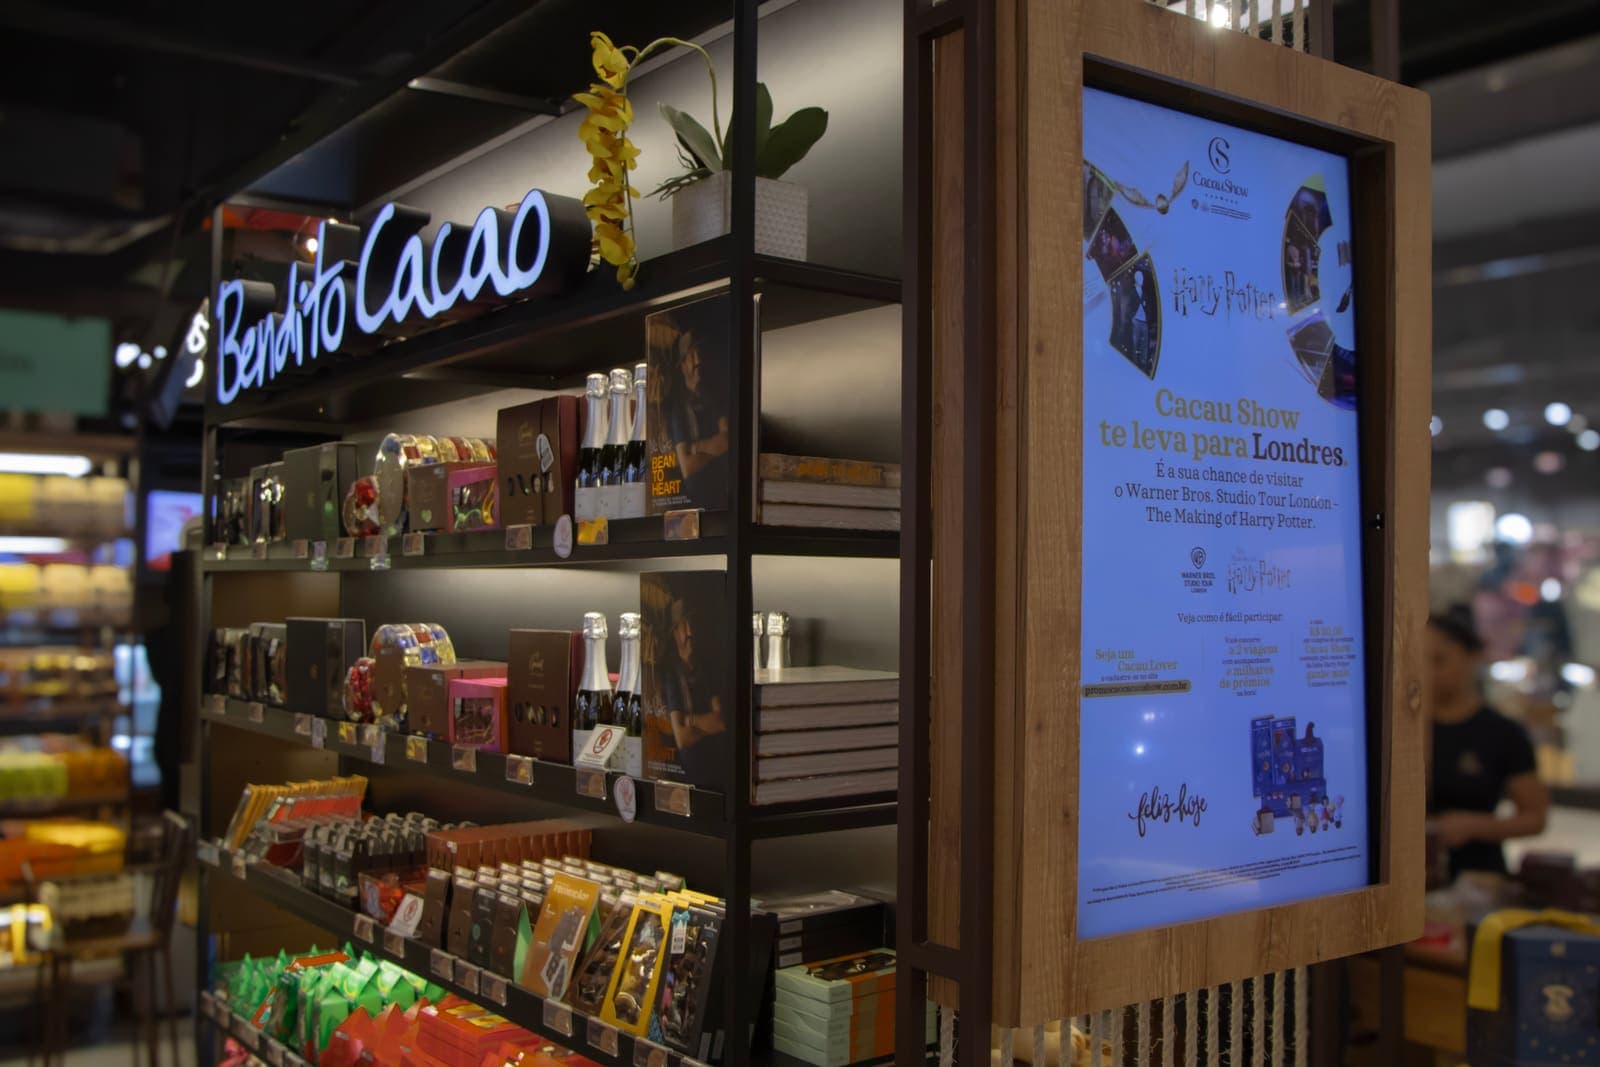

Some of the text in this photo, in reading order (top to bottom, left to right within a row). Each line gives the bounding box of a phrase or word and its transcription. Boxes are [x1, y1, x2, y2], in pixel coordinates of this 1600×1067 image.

[216, 219, 346, 404] Bendito
[354, 187, 551, 334] Cacao
[1172, 266, 1277, 322] Harry Potter
[1155, 388, 1300, 431] Cacau Show
[1099, 419, 1127, 448] te
[1132, 421, 1188, 453] leva
[1191, 434, 1249, 462] para
[651, 453, 676, 470] BEAN
[652, 468, 665, 483] TO
[1156, 458, 1304, 488] É a sua chance de visitar
[651, 479, 682, 497] HEART
[1114, 486, 1123, 498] o
[1126, 482, 1179, 502] Warner
[1181, 486, 1213, 504] Bros.
[1216, 488, 1255, 506] Studio
[1258, 491, 1286, 508] Tour
[1288, 493, 1332, 510] London
[1146, 506, 1316, 531] The Making of Harry Potter.
[1177, 612, 1196, 625] Veja
[1196, 613, 1219, 623] como
[1219, 612, 1225, 623] é
[1225, 611, 1243, 623] fácil
[1128, 783, 1208, 838] feliz hoje
